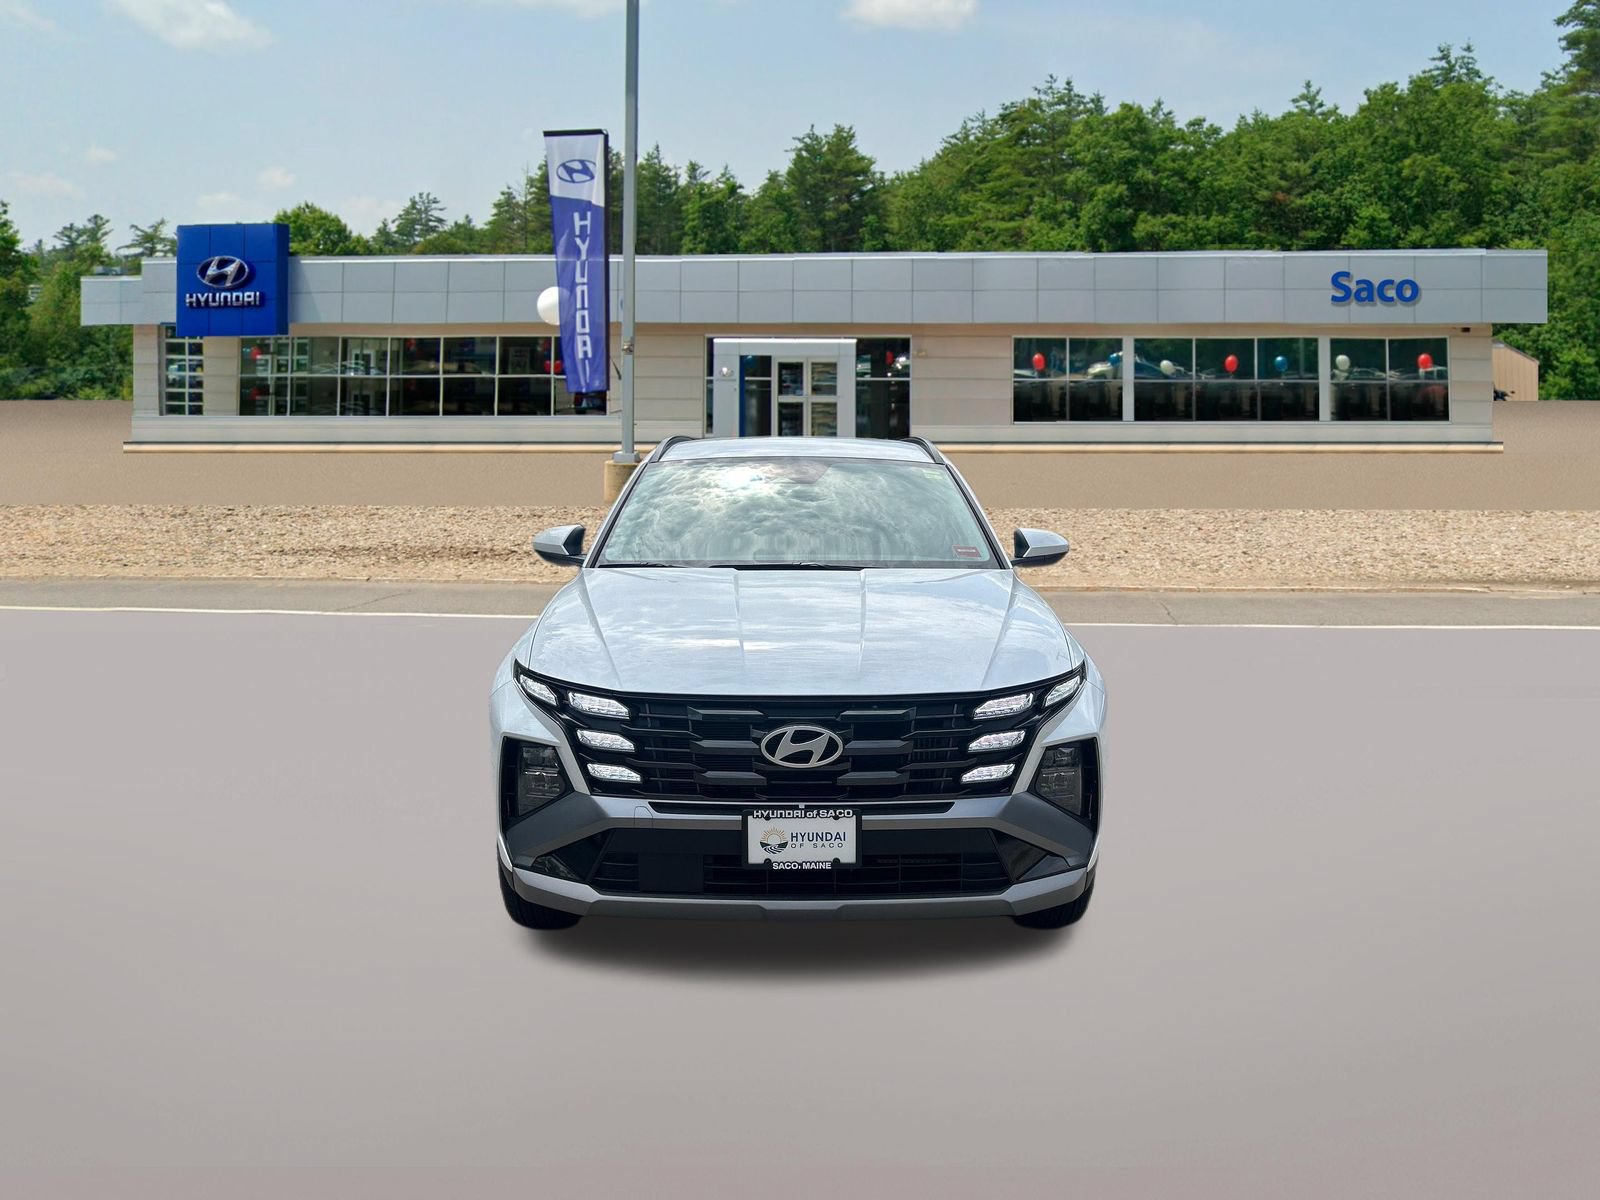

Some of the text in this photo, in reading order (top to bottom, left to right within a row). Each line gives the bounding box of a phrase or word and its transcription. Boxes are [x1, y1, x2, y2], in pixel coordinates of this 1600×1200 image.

[1330, 270, 1420, 304] Saco
[185, 291, 261, 307] HYUNDAI
[573, 211, 593, 383] HYUNDAI
[753, 809, 853, 818] HYUNDAI of SACO
[790, 831, 846, 842] HYUNDAI
[802, 862, 832, 870] MAINE
